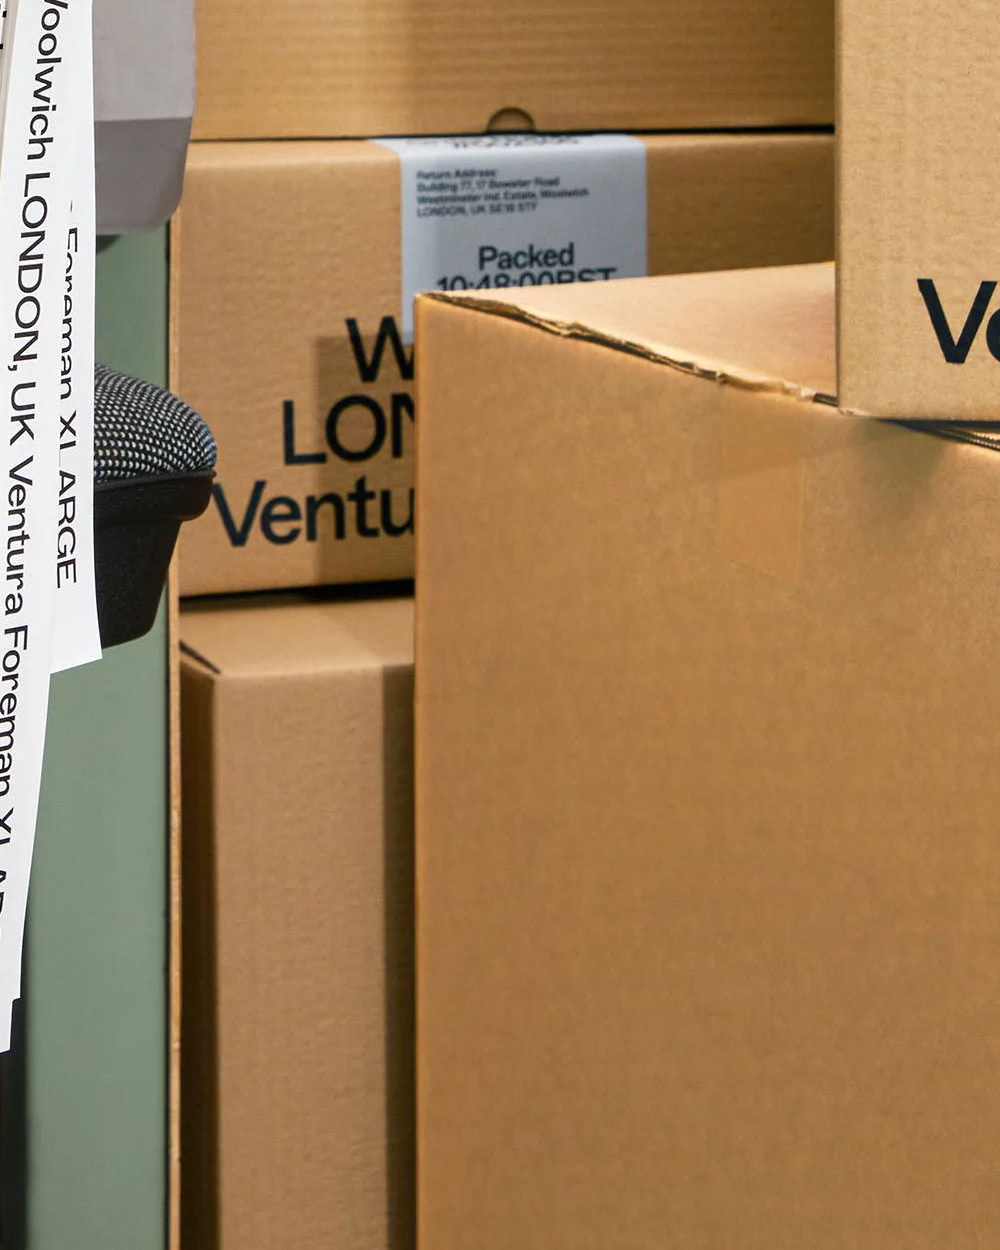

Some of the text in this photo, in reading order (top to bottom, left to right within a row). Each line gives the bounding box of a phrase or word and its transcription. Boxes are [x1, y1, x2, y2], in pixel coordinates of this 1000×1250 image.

[8, 172, 51, 371] LONDON,
[478, 242, 575, 271] Packed
[9, 382, 36, 446] UK
[5, 455, 34, 616] Ventura
